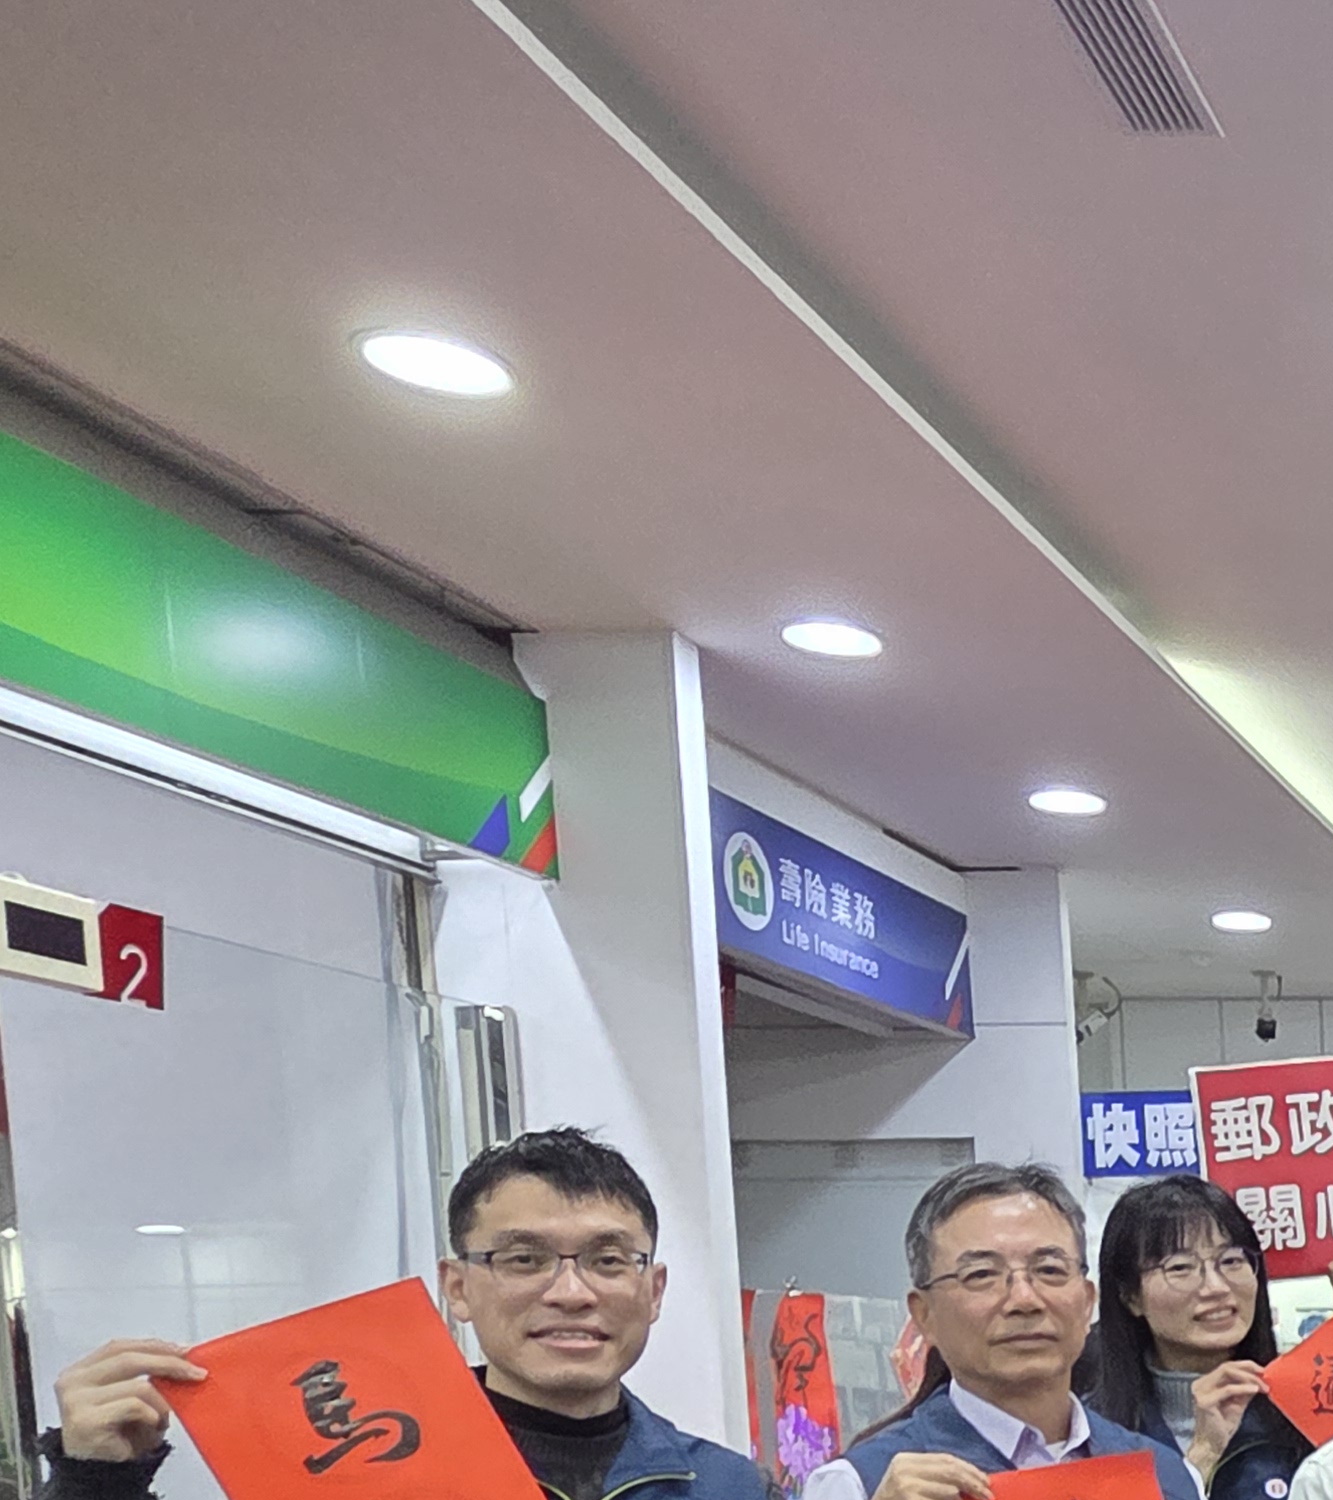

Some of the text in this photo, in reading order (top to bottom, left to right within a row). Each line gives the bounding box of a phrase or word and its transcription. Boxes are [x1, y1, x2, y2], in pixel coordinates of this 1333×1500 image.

[779, 858, 876, 940] 壽險業務
[119, 943, 148, 1007] 2
[781, 919, 880, 980] Life Insurance
[1087, 1103, 1197, 1168] 快照
